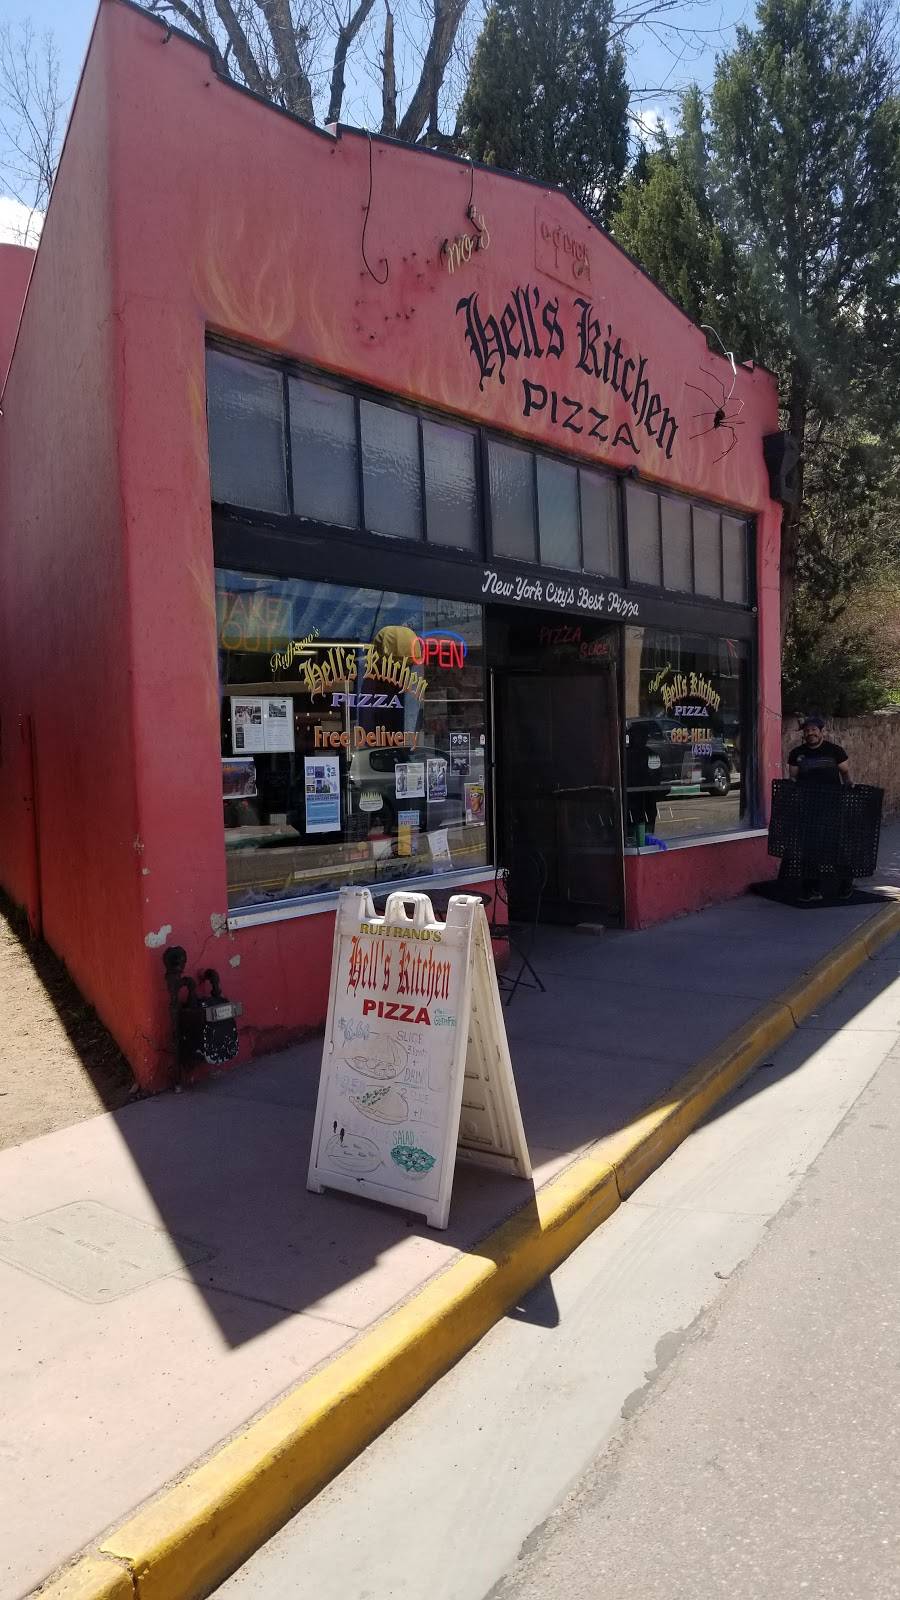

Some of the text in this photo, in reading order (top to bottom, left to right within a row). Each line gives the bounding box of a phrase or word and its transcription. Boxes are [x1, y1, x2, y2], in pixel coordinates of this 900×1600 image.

[456, 284, 679, 459] Hell's Kitchen
[522, 378, 640, 455] PIZZA
[482, 570, 639, 617] New York City's Best Pizza
[412, 637, 465, 669] OPEN
[299, 644, 429, 704] Hell's Kitchen
[660, 673, 688, 712] Hell's
[689, 671, 720, 712] Kitchen
[331, 692, 404, 709] PIZZA
[674, 705, 709, 717] PIZZA
[314, 726, 350, 748] Free
[354, 726, 419, 751] Delivery
[346, 935, 451, 1007] Hell's Kitchen
[362, 999, 431, 1026] PIZZA
